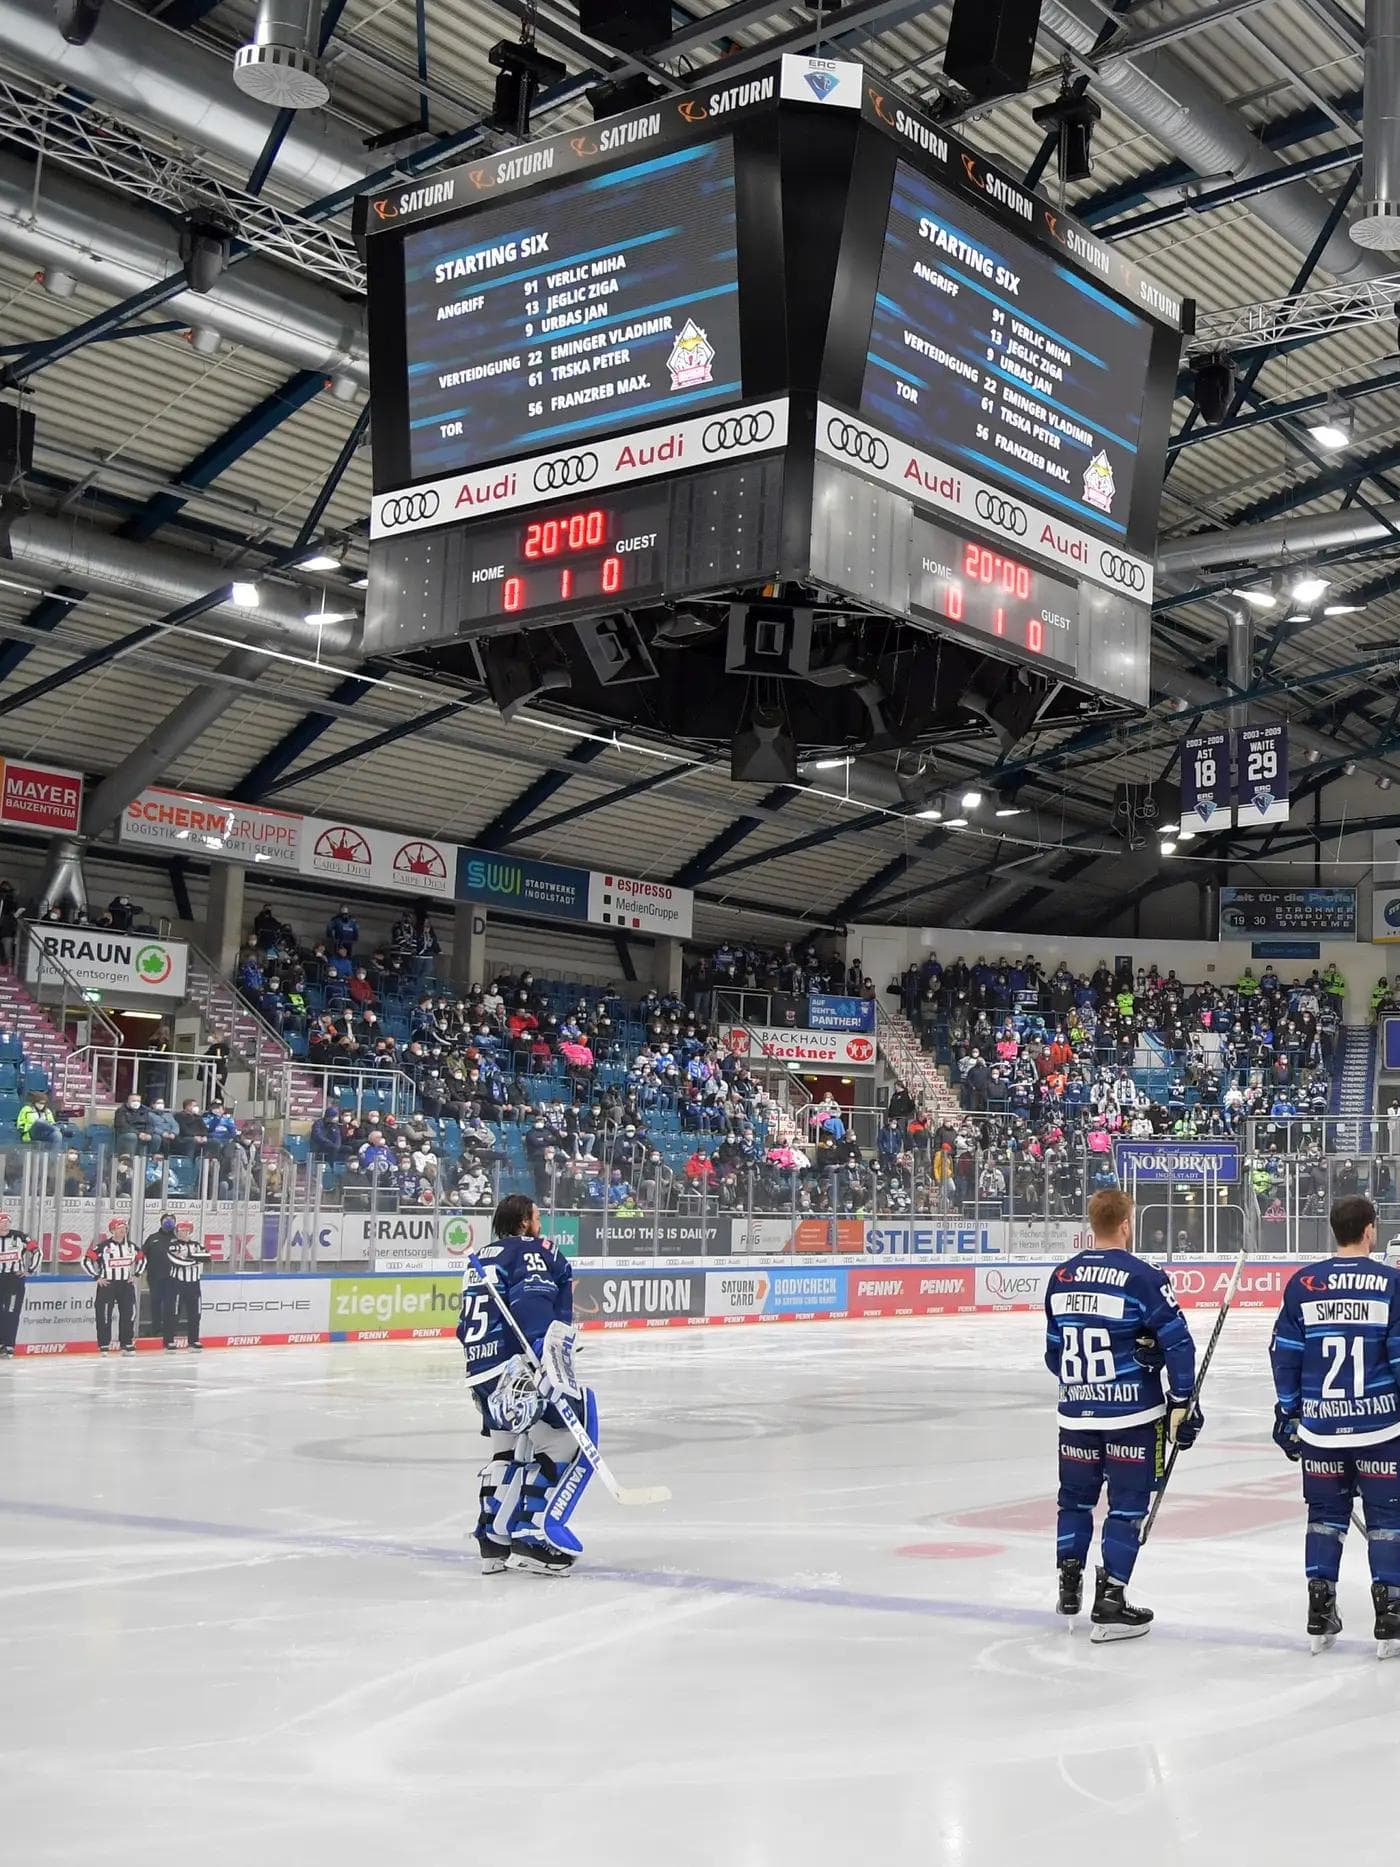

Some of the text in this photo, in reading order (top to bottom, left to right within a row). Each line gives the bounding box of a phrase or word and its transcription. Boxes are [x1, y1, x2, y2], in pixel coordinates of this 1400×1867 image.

[709, 76, 774, 116] SATURN
[600, 113, 661, 151] SATURN
[895, 110, 948, 163] SATURN
[497, 148, 554, 183] SATURN
[400, 180, 455, 214] SATURN
[986, 172, 1033, 221] SATURN
[435, 232, 550, 284] STARTING SIX
[918, 218, 1021, 295] STARTING SIX
[1067, 230, 1109, 274] SATURN
[524, 256, 626, 296] 91 VERLIC MIHA
[913, 261, 959, 297] ANGRIFF
[436, 296, 484, 321] ANGRIFF
[525, 279, 619, 316] 13 JEGLIC ZIGA
[525, 304, 608, 338] 9 URBAS JAN
[439, 316, 672, 389] VERTEIDIGUNG 22 EMINGER VLADIMIR
[528, 349, 630, 387] 61 TRSKA PETER
[529, 378, 651, 417] 56 FRANZREB MAX.
[440, 422, 463, 438] TOR
[455, 433, 684, 508] Audi Audi
[904, 457, 1088, 564] Audi Audi
[616, 534, 657, 553] GUEST
[472, 565, 504, 584] HOME
[922, 558, 952, 579] HOME
[1041, 609, 1071, 630] GUEST
[1197, 749, 1213, 760] AST
[1250, 740, 1274, 752] WAITE
[1195, 760, 1216, 788] 18
[1248, 751, 1277, 781] 29
[6, 777, 77, 805] MAYER
[5, 798, 76, 819] BAUZENTRUM
[127, 800, 225, 833] SCHERM
[126, 822, 295, 859] LOGISTIK SERVICE
[525, 879, 576, 896] STADTWERKE
[525, 890, 576, 905] INGOLSTADT
[617, 877, 673, 900] espresso
[616, 897, 679, 920] MedienGruppe
[473, 918, 486, 935] D
[1254, 917, 1265, 925] 30
[44, 937, 131, 965] BRAUN
[76, 967, 130, 984] entsorgen
[812, 1015, 861, 1027] PANTHER!
[762, 1032, 837, 1046] BACKHAUS
[1129, 1155, 1223, 1172] NORDBRÄU
[363, 1220, 440, 1240] BRAUN
[596, 1227, 635, 1239] HELLO!
[667, 1228, 677, 1239] IS
[866, 1230, 1000, 1254] STIEFEL
[523, 1253, 547, 1272] 35
[721, 1281, 754, 1293] SATURN
[774, 1278, 837, 1294] BODYCHECK
[1074, 1266, 1129, 1287] SATURN
[1328, 1273, 1388, 1292] SATURN
[25, 1298, 67, 1312] Immer
[200, 1299, 311, 1313] PORSCHE
[603, 1279, 690, 1314] SATURN
[730, 1293, 754, 1306] CARD
[1066, 1294, 1098, 1313] PIETTA
[1316, 1302, 1369, 1321] SIMPSON
[1061, 1327, 1117, 1384] 86
[1322, 1335, 1365, 1399] 21
[1303, 1393, 1397, 1419] ERC INGOLSTADT
[1061, 1443, 1146, 1460] CINQUE CINQUE
[1305, 1459, 1397, 1475] CINQUE CINQUE
[550, 1465, 587, 1521] VAUGHN
